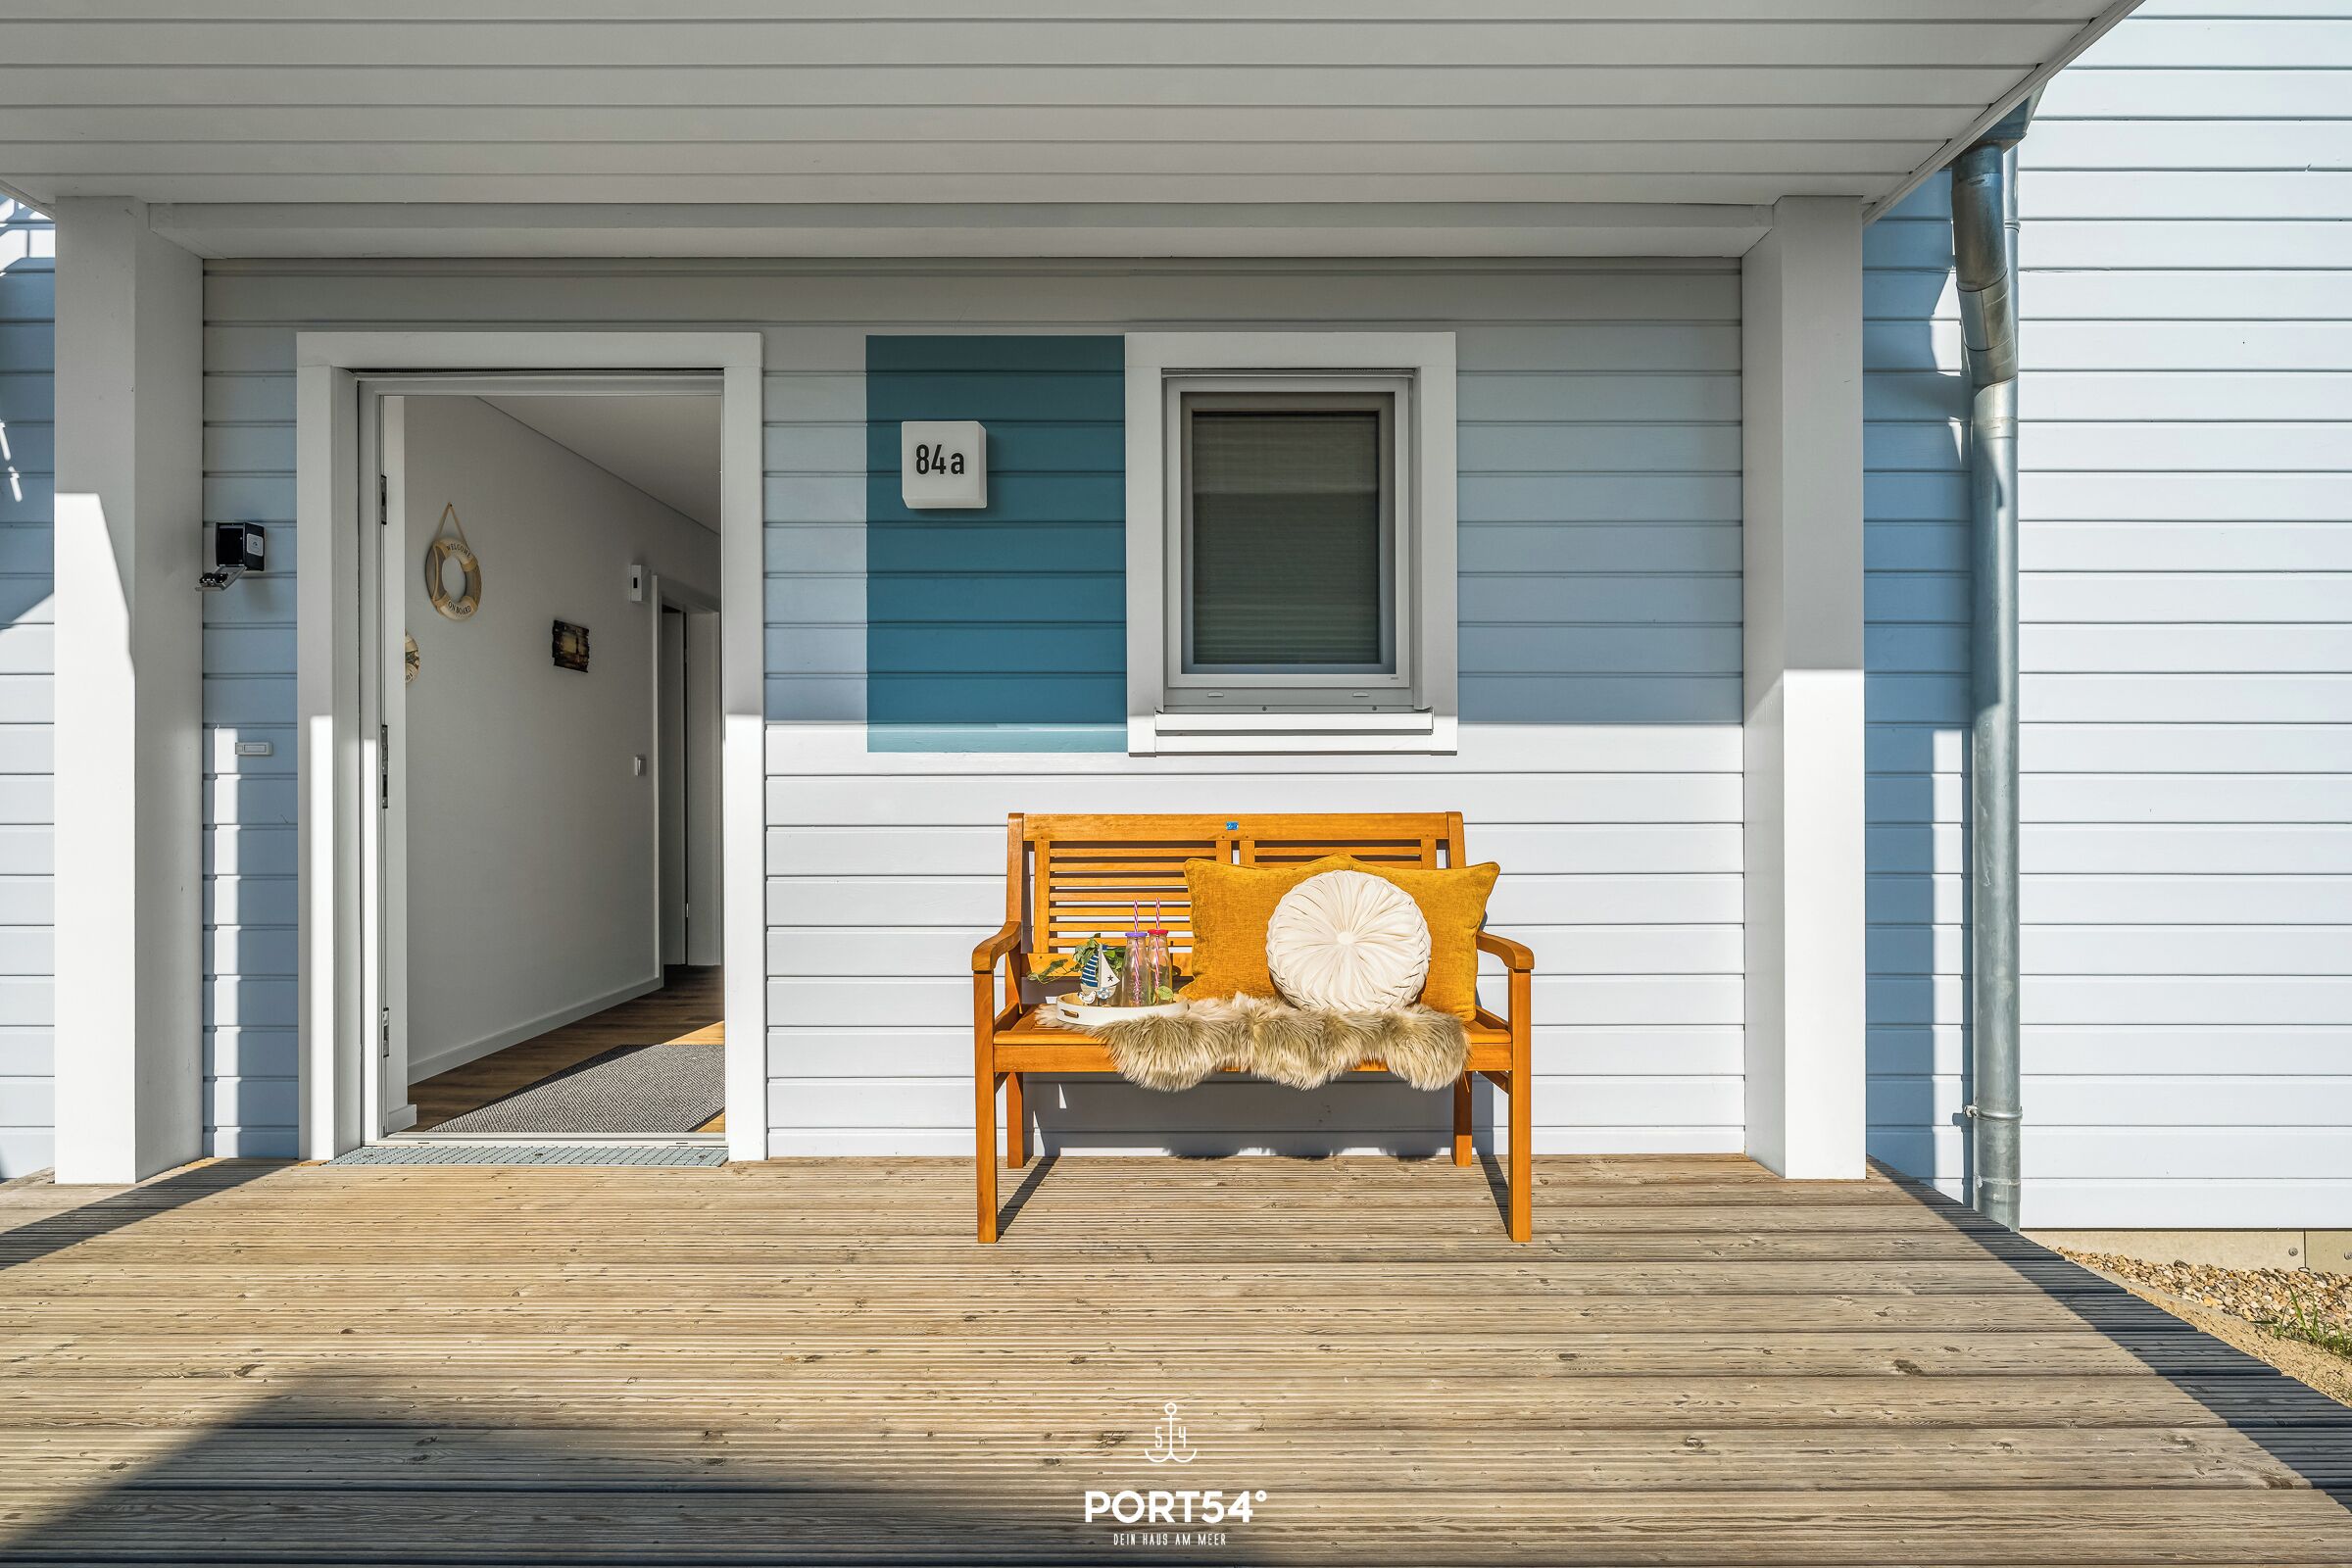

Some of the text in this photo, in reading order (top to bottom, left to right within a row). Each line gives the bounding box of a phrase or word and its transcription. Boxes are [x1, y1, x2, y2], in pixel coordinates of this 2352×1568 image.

[915, 443, 965, 475] 84a
[446, 543, 471, 559] WELCOME
[448, 601, 472, 615] ON BOARD
